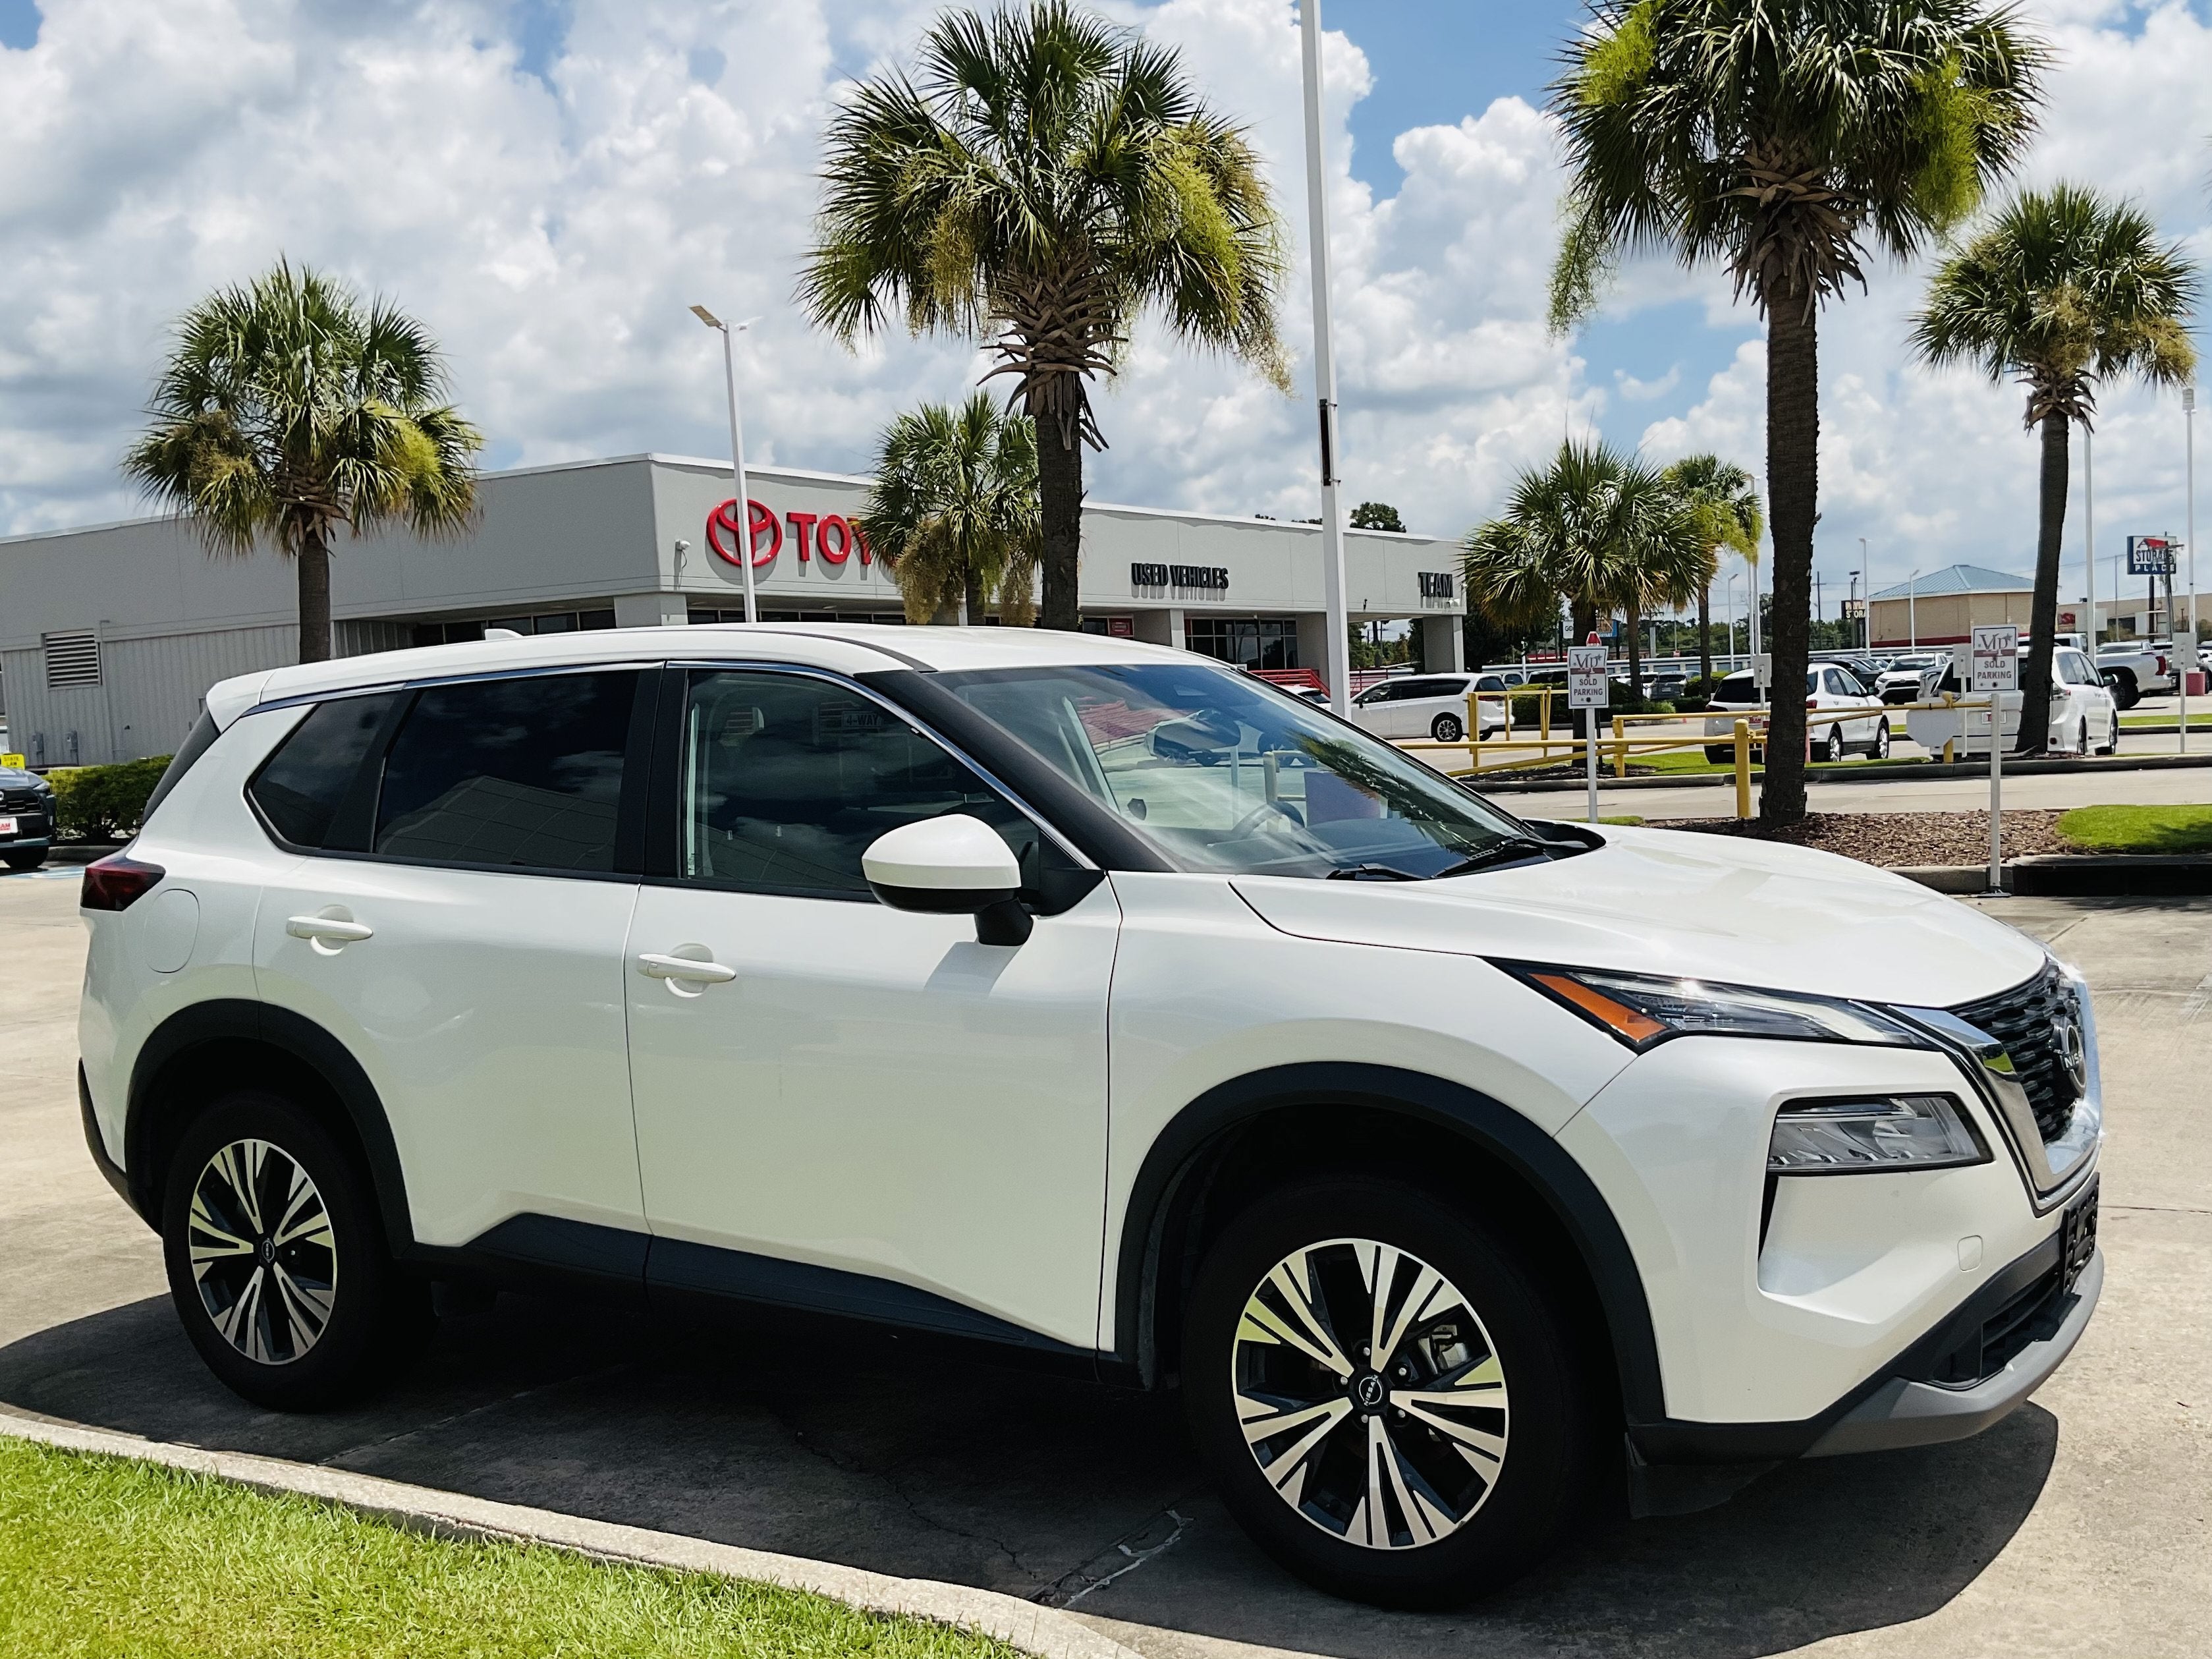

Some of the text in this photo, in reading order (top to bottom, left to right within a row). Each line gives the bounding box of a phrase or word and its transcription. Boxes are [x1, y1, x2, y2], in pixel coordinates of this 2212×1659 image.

[786, 512, 893, 567] TOY
[1131, 563, 1229, 589] USED VEHICLES
[1418, 572, 1453, 598] TEAM
[846, 714, 879, 725] 4-WAY
[1364, 1374, 1379, 1407] NISSAN
